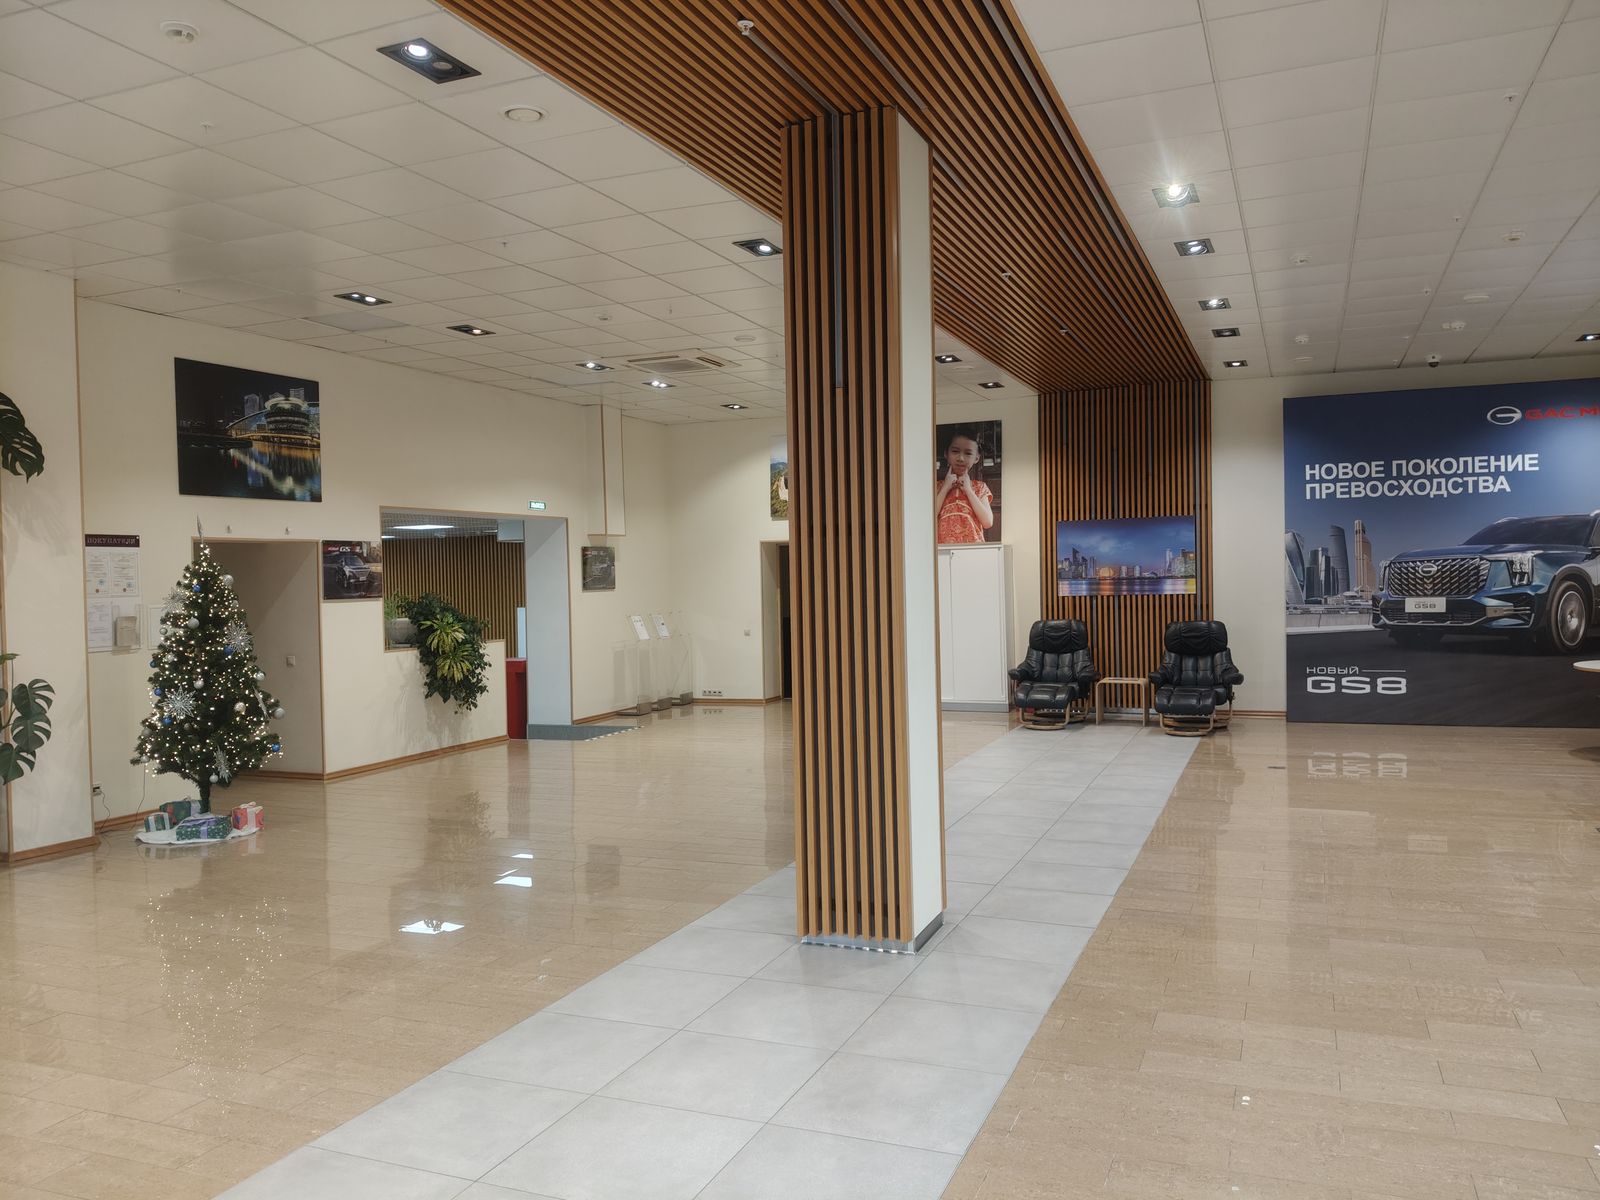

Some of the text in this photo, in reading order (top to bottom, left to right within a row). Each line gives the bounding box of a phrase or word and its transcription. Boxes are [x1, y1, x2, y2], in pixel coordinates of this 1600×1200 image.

[1525, 406, 1577, 420] GAC
[1305, 453, 1540, 481] НОВОЕ ПОКОЛЕНИЕ
[1305, 475, 1511, 500] ПРЕВОСХОДСТВА
[1306, 666, 1359, 675] НОВЫЙ
[1306, 676, 1407, 695] GS8
